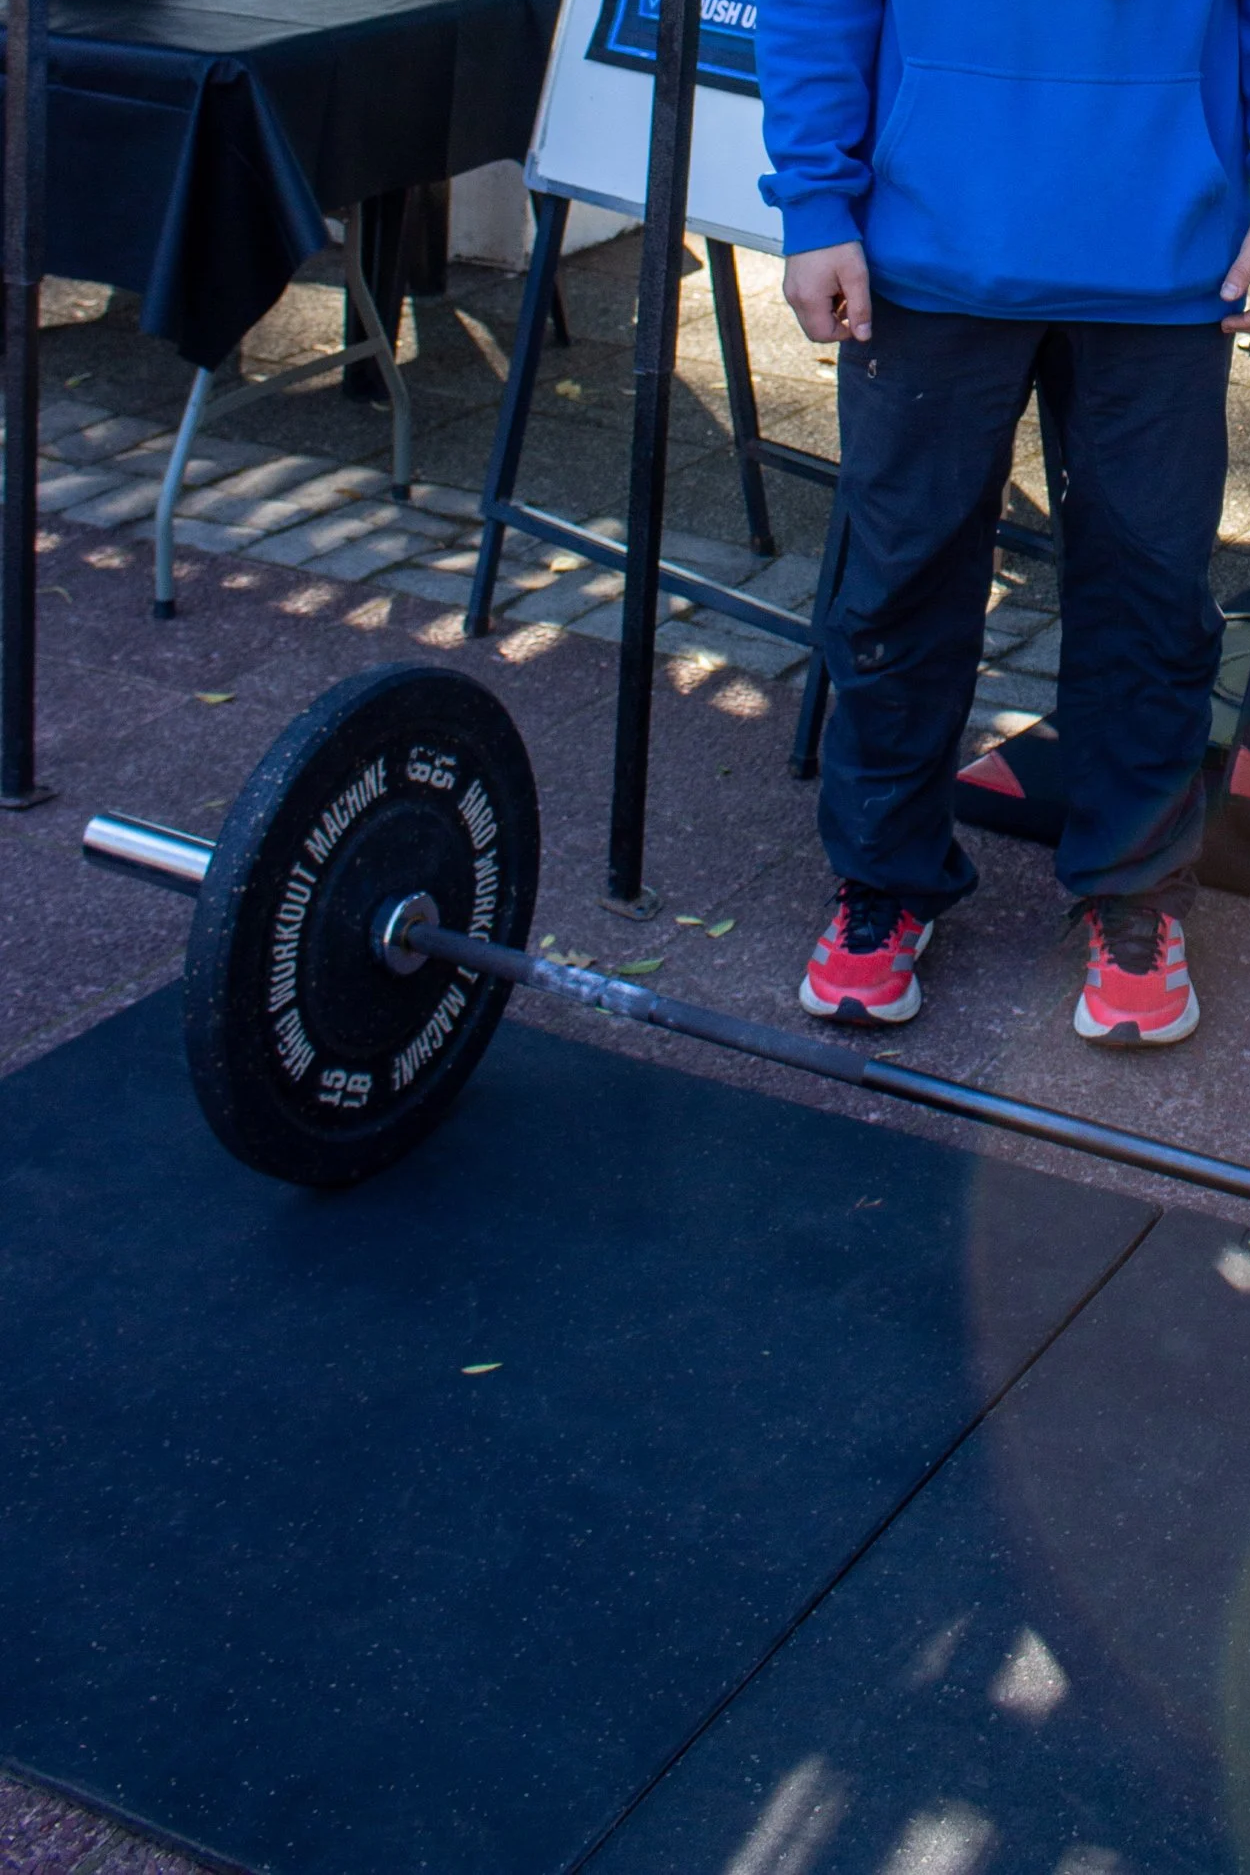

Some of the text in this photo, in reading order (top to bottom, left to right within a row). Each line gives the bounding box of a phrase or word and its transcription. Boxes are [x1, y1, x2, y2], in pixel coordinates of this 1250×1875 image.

[303, 756, 388, 865] MACHINE
[458, 778, 498, 850] HARD
[392, 984, 466, 1091] MACHINE
